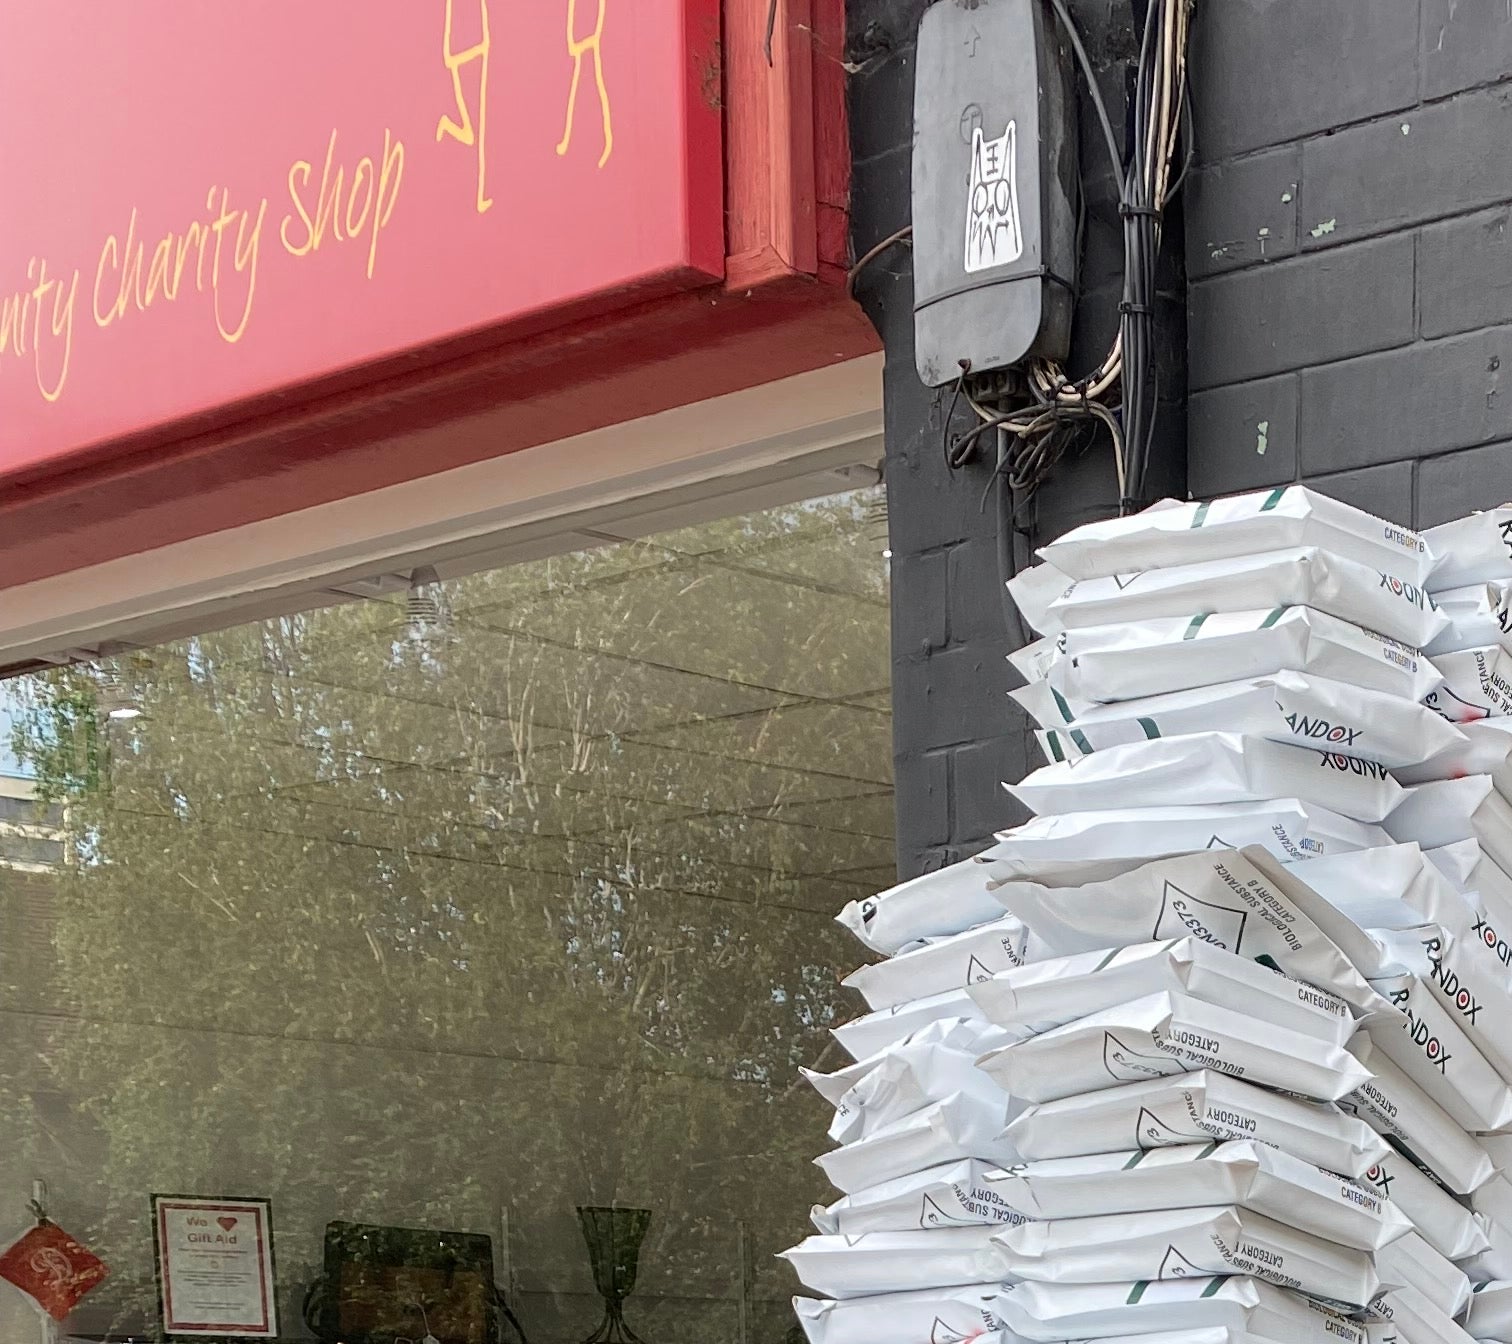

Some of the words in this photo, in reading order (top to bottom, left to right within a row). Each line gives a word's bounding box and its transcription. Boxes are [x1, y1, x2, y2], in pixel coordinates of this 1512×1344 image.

[0, 257, 80, 401] nity
[93, 206, 267, 343] Charity
[281, 128, 404, 280] Shop
[1384, 526, 1418, 551] CATEGORY
[1418, 541, 1425, 553] B
[1379, 568, 1438, 613] ANDOX
[1276, 701, 1364, 748] ANDOX
[1321, 750, 1389, 782] ANDOX
[1212, 864, 1261, 910] SUBSTANCE
[1247, 879, 1257, 892] B
[1252, 885, 1297, 924] CATEGORY
[1257, 907, 1303, 953] BIOLOGICAL
[1421, 937, 1483, 1026] RANDOX
[1298, 988, 1340, 1015] CATEGORY
[1340, 1005, 1346, 1017] B
[1167, 1028, 1220, 1054] CATEGORY
[1360, 1083, 1398, 1118] CATEGORY
[1206, 1107, 1257, 1133] CATEGORY
[1341, 1186, 1376, 1213] CATEGORY
[187, 1233, 211, 1243] Gift
[215, 1234, 238, 1245] Aid
[1239, 1247, 1284, 1269] CATEGORY
[1373, 1299, 1395, 1320] CATE
[1325, 1319, 1358, 1343] CATEGORY
